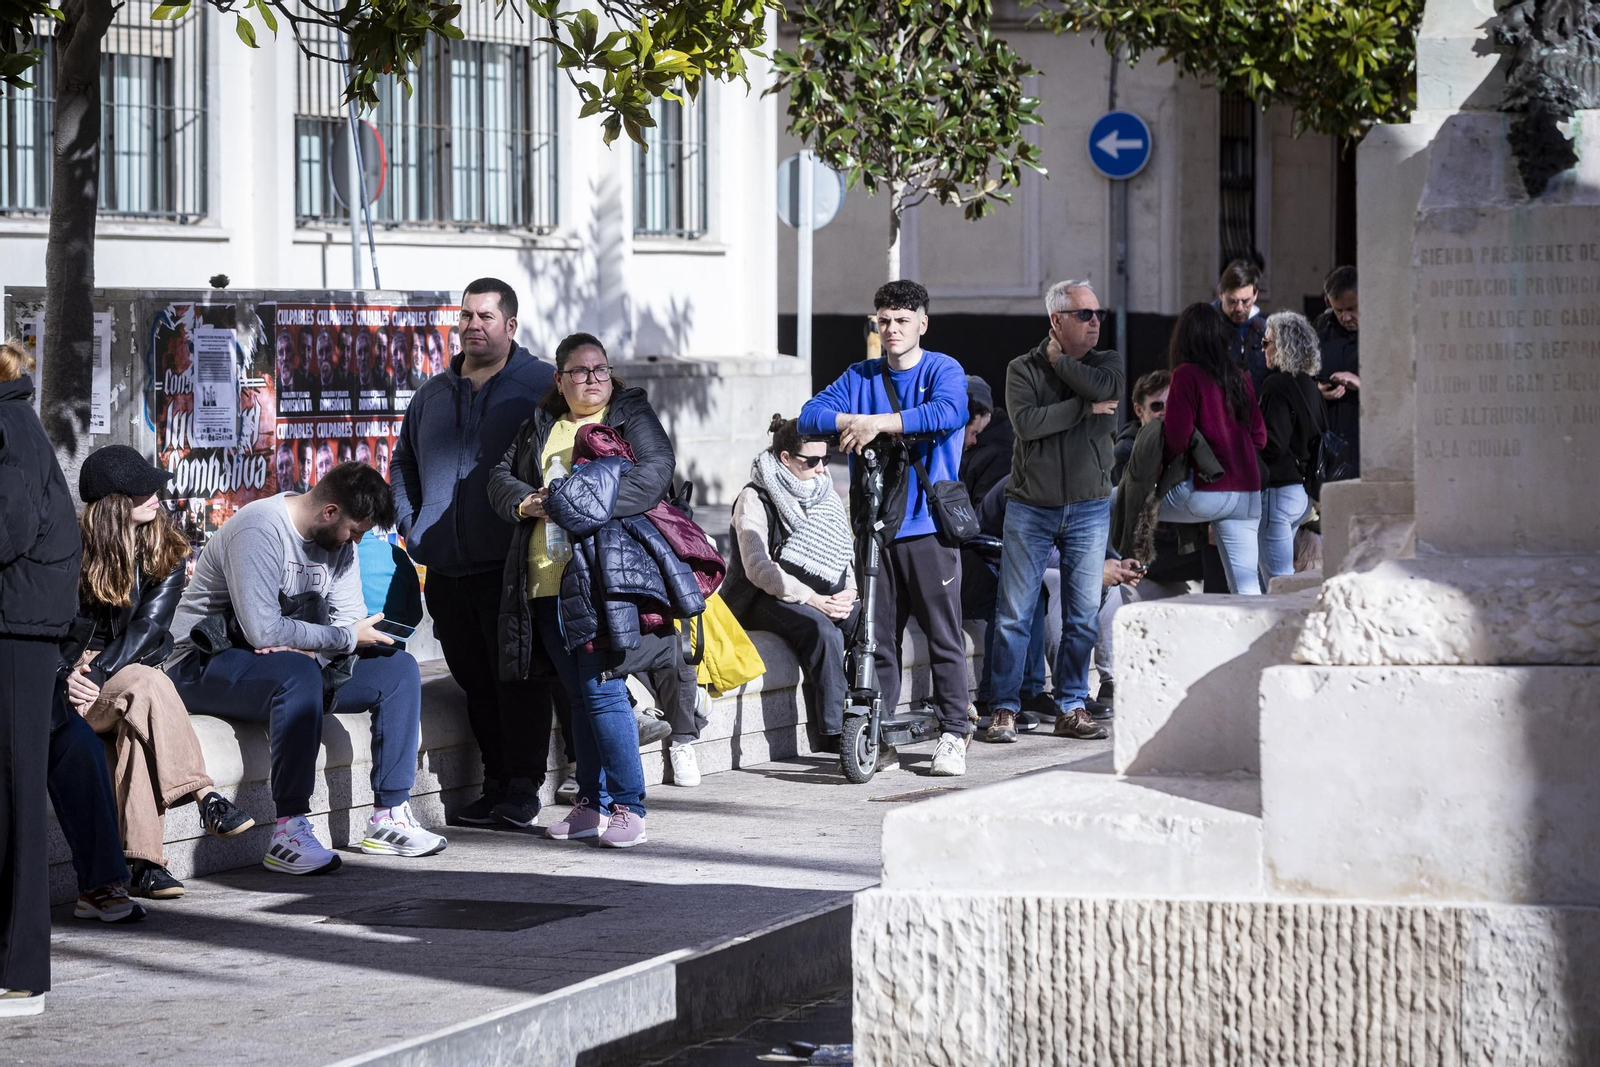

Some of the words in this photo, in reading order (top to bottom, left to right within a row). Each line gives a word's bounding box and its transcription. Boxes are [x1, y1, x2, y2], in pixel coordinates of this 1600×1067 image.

[1420, 247, 1473, 265] SIENDO
[1481, 244, 1574, 263] PRESIDENTE
[1579, 243, 1600, 262] DE
[1430, 279, 1518, 297] DIPUTACION
[277, 309, 314, 326] CULPABLES
[317, 309, 354, 326] CULPABLES
[356, 310, 390, 326] CULPABLES
[392, 311, 426, 327] CULPABLES
[429, 310, 461, 326] CULPABLE
[1458, 310, 1526, 328] ALCALDE
[1533, 309, 1553, 327] DE
[1478, 374, 1499, 393] UN
[1506, 373, 1545, 392] GRAN
[1434, 408, 1454, 426] DE
[1461, 406, 1547, 425] ALTRUISMO
[277, 423, 314, 439] CULPABLES
[317, 422, 353, 438] CULPABLES
[355, 421, 389, 437] CULPABLES
[1468, 439, 1522, 457] CIUDAD
